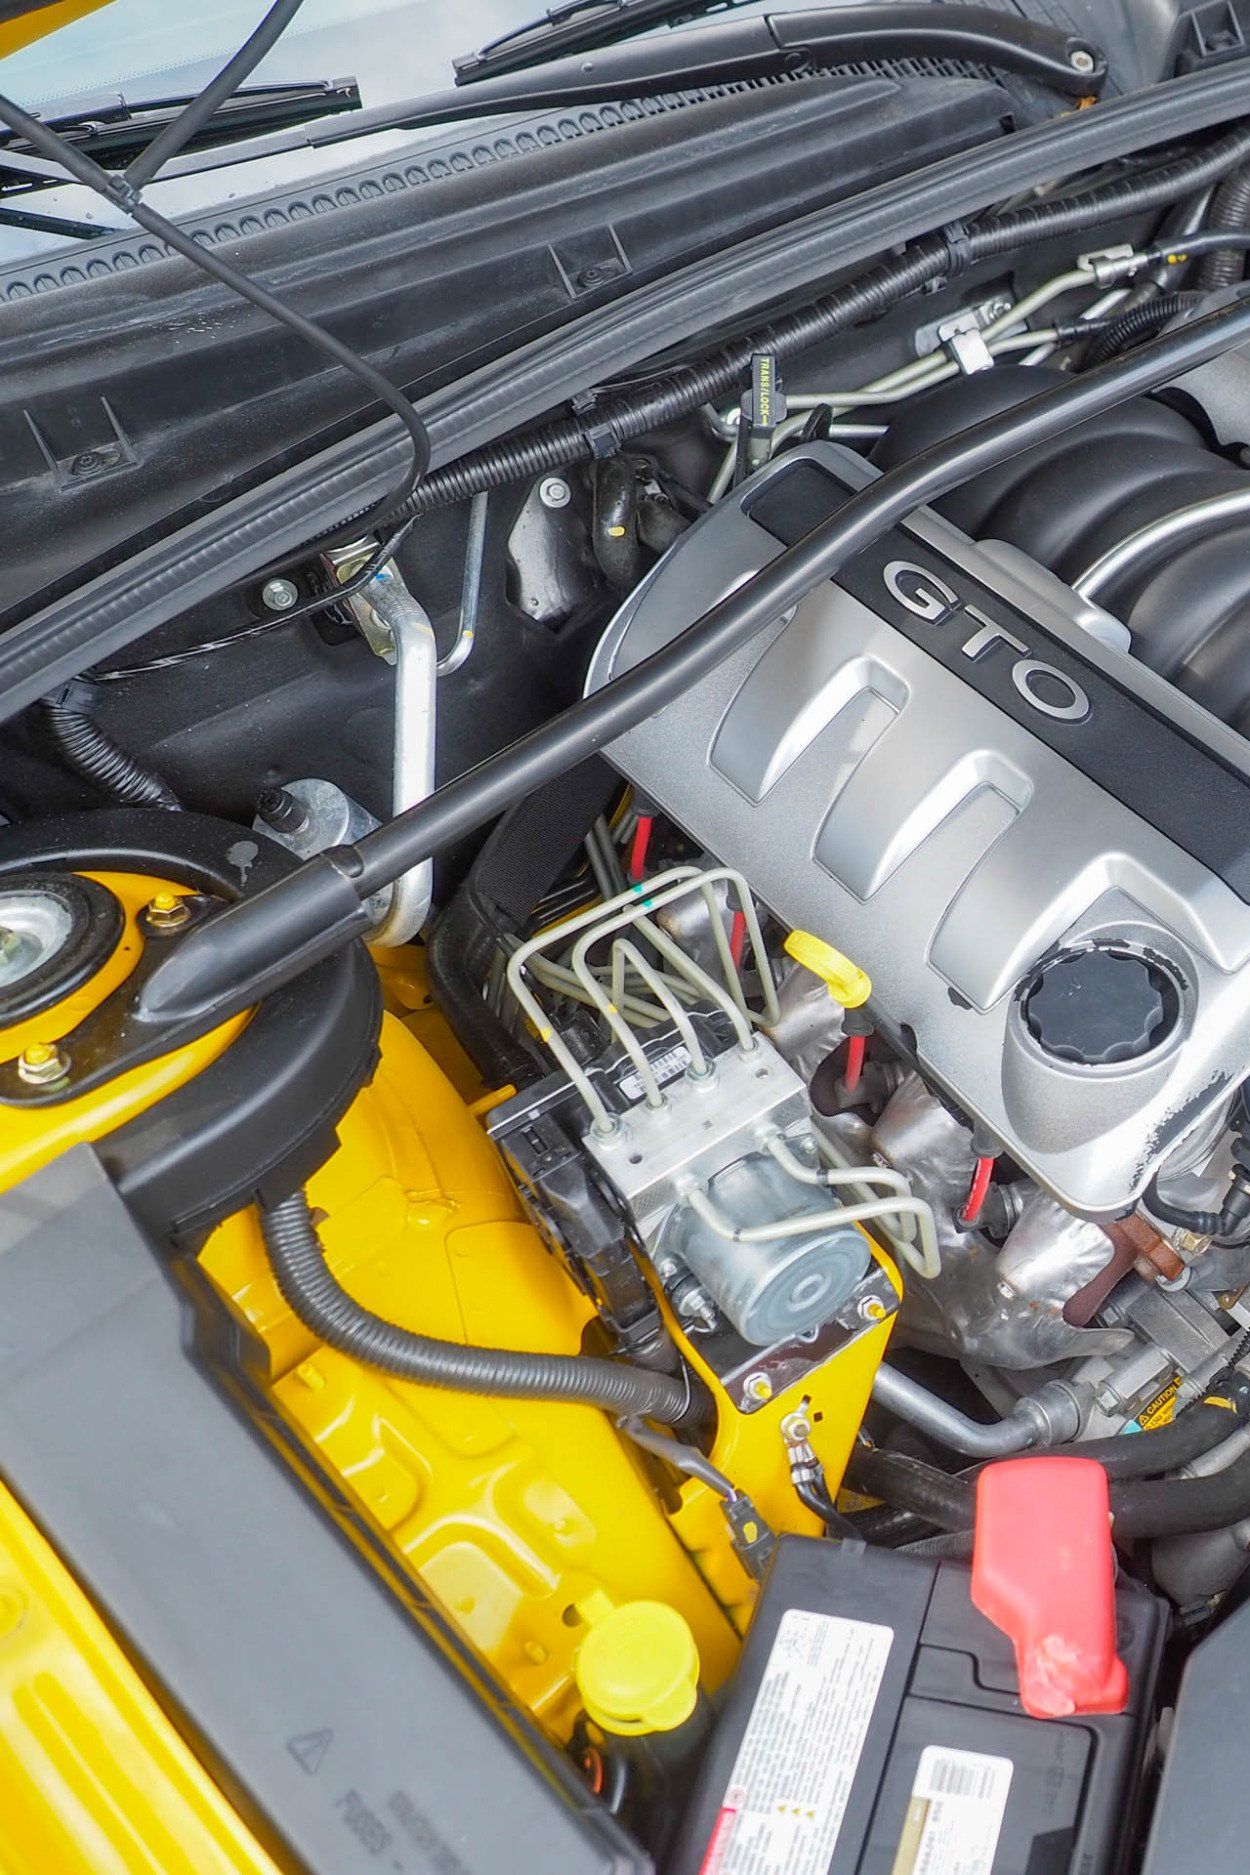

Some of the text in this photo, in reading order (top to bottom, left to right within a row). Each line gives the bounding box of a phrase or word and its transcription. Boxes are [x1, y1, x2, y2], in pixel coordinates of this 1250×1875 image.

[760, 356, 770, 416] TRANS/LOCK
[882, 560, 1090, 722] GTO
[1147, 1384, 1178, 1415] CAUTION
